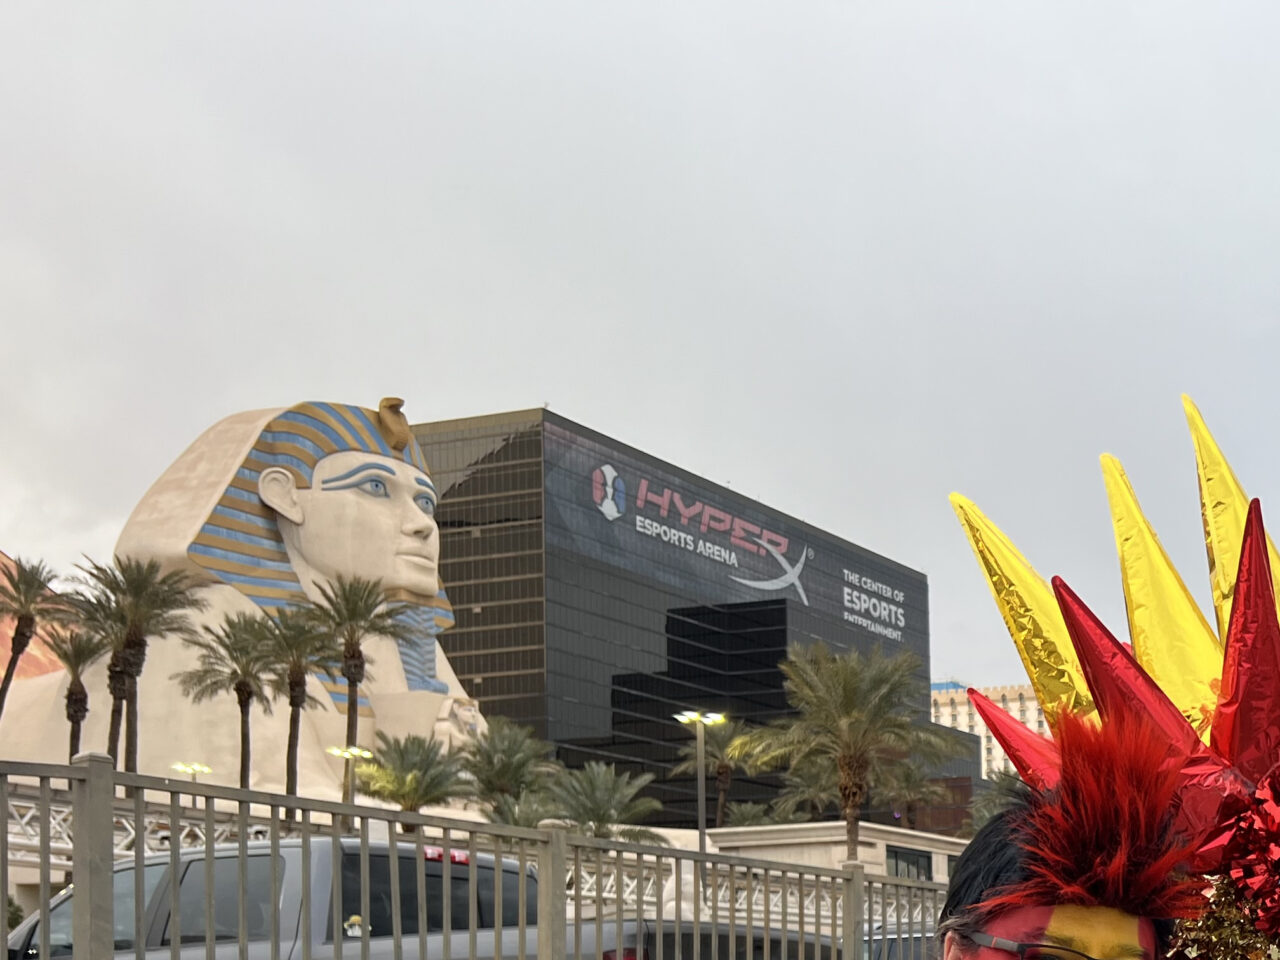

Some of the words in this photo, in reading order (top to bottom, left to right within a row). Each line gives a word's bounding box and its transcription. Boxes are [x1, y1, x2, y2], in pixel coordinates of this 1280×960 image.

[636, 515, 694, 550] ESPORTS
[697, 540, 738, 567] ARENA
[843, 569, 860, 586] THE
[861, 577, 893, 599] CENTER
[893, 590, 905, 603] OF
[843, 586, 906, 628] ESPORTS
